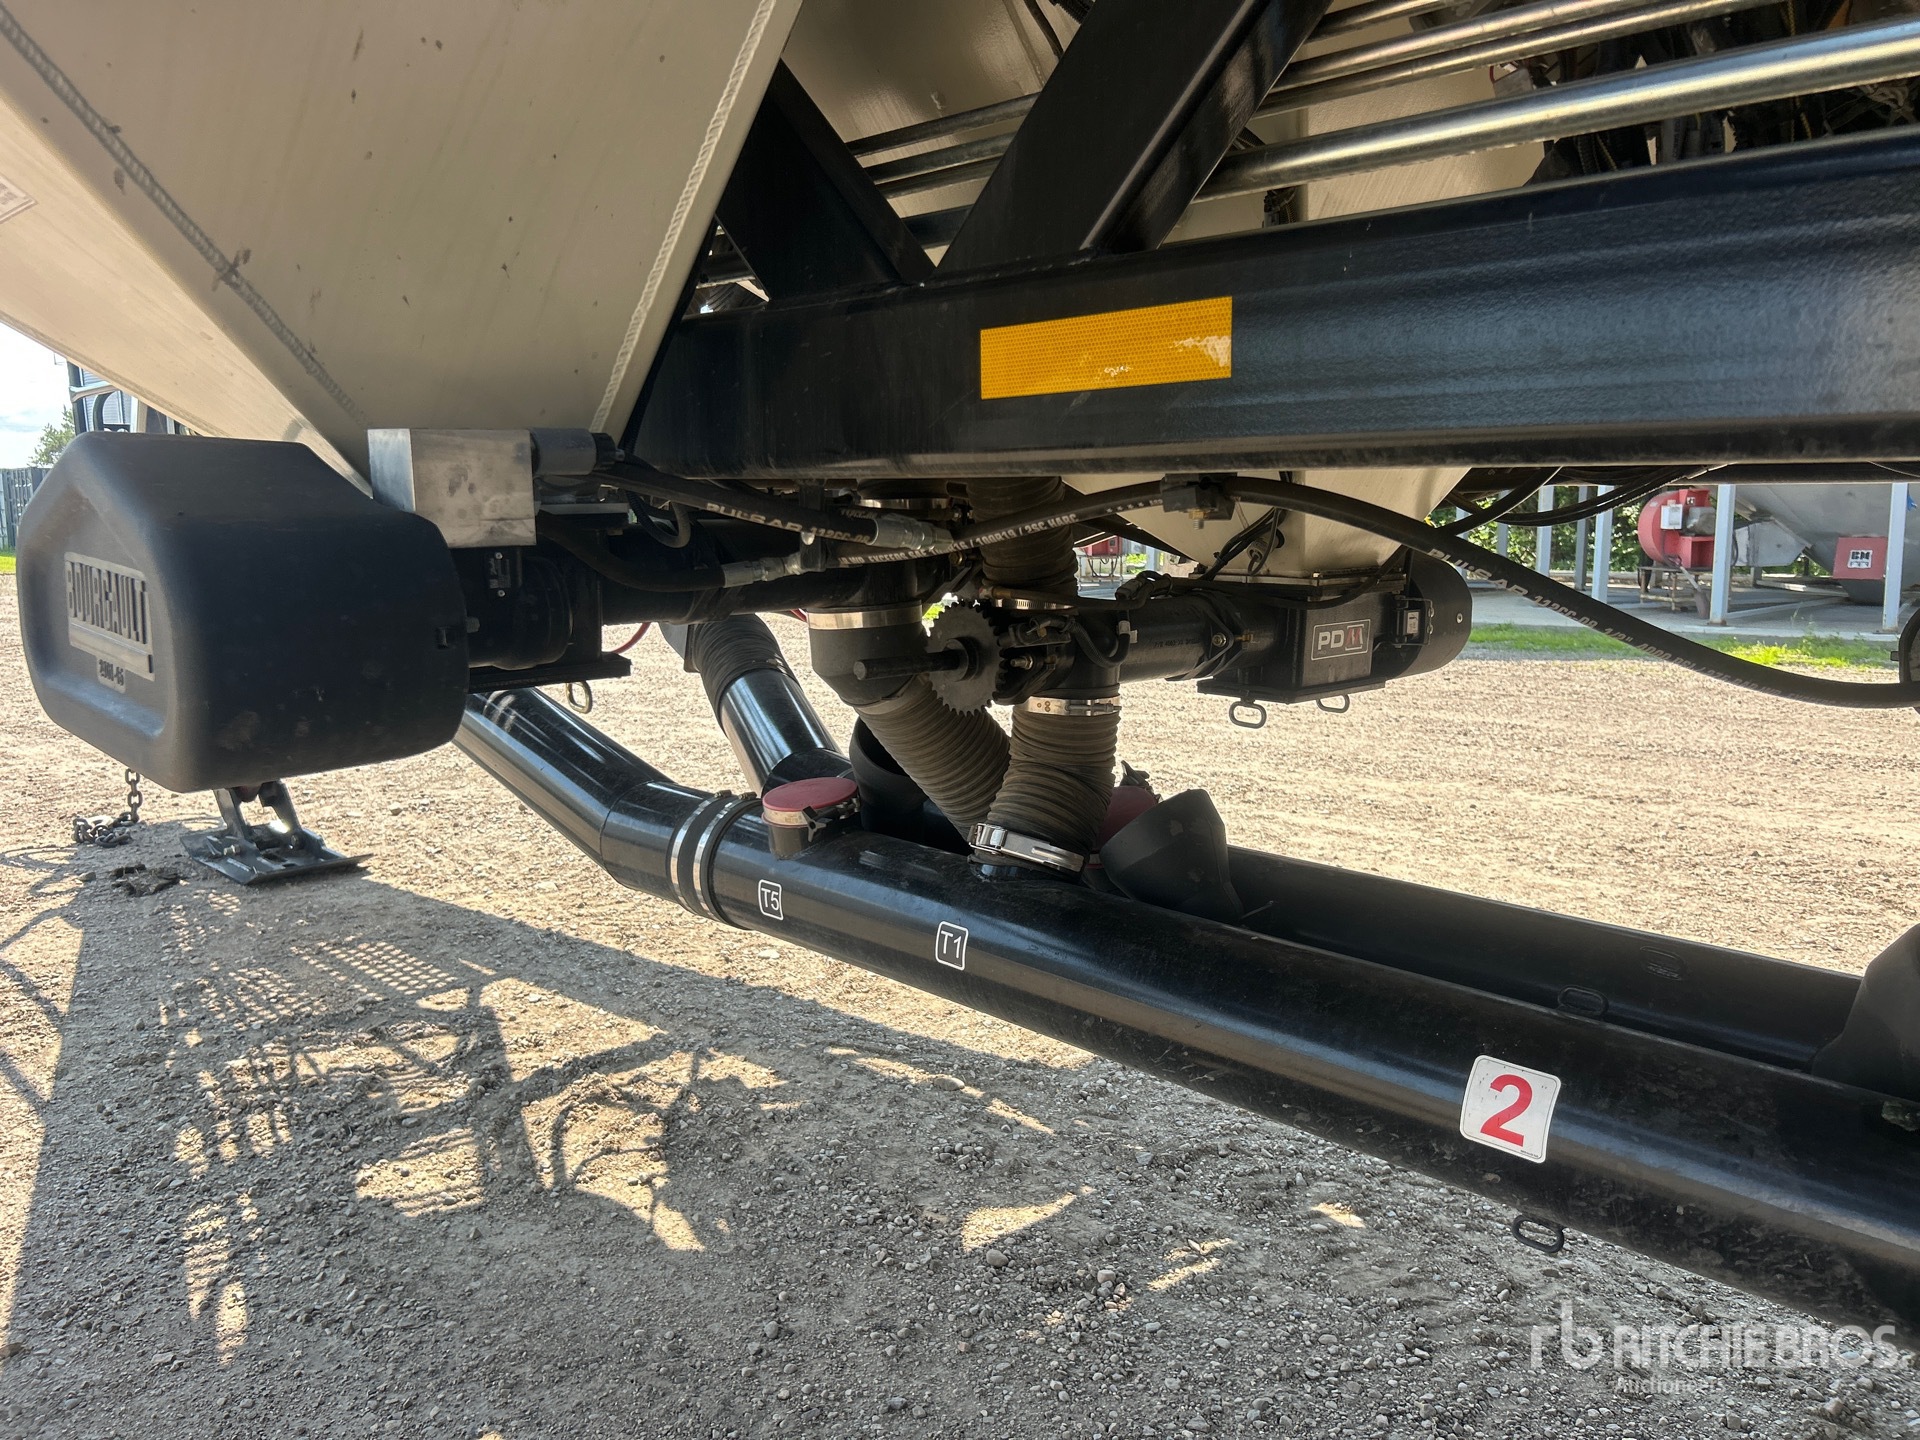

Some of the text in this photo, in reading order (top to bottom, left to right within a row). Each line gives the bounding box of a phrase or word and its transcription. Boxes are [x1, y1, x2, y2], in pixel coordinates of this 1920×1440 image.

[65, 561, 148, 645] BOURGAULT
[760, 887, 780, 911] T5
[940, 930, 962, 959] T1
[1479, 1073, 1533, 1147] 2
